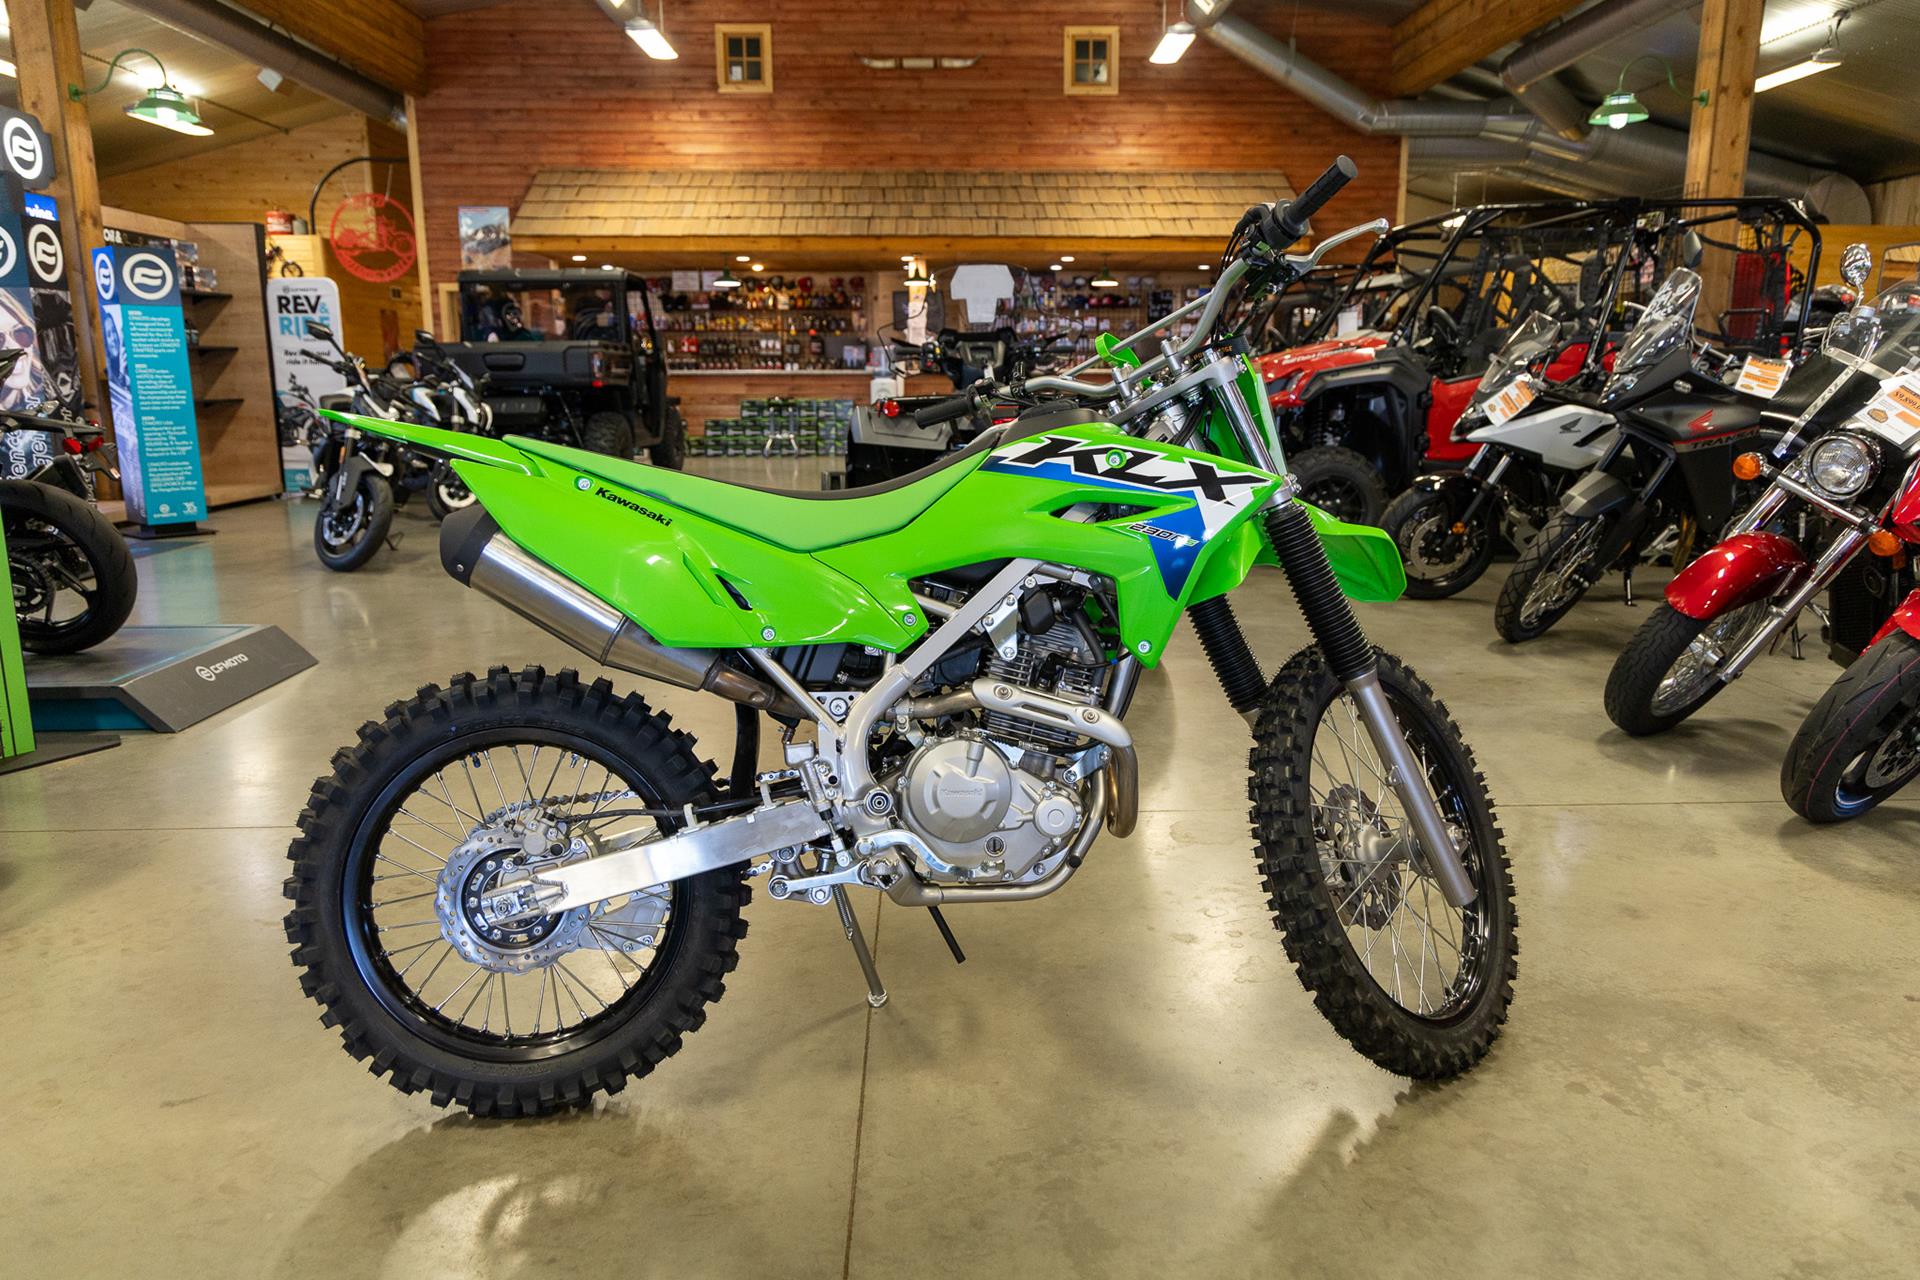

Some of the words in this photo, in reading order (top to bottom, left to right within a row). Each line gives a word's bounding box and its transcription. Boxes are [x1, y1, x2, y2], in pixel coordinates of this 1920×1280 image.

[277, 295, 322, 314] REV
[320, 303, 329, 313] &
[1008, 434, 1274, 508] KLX
[595, 487, 673, 527] Kawasaki
[210, 654, 249, 674] CFMOTO
